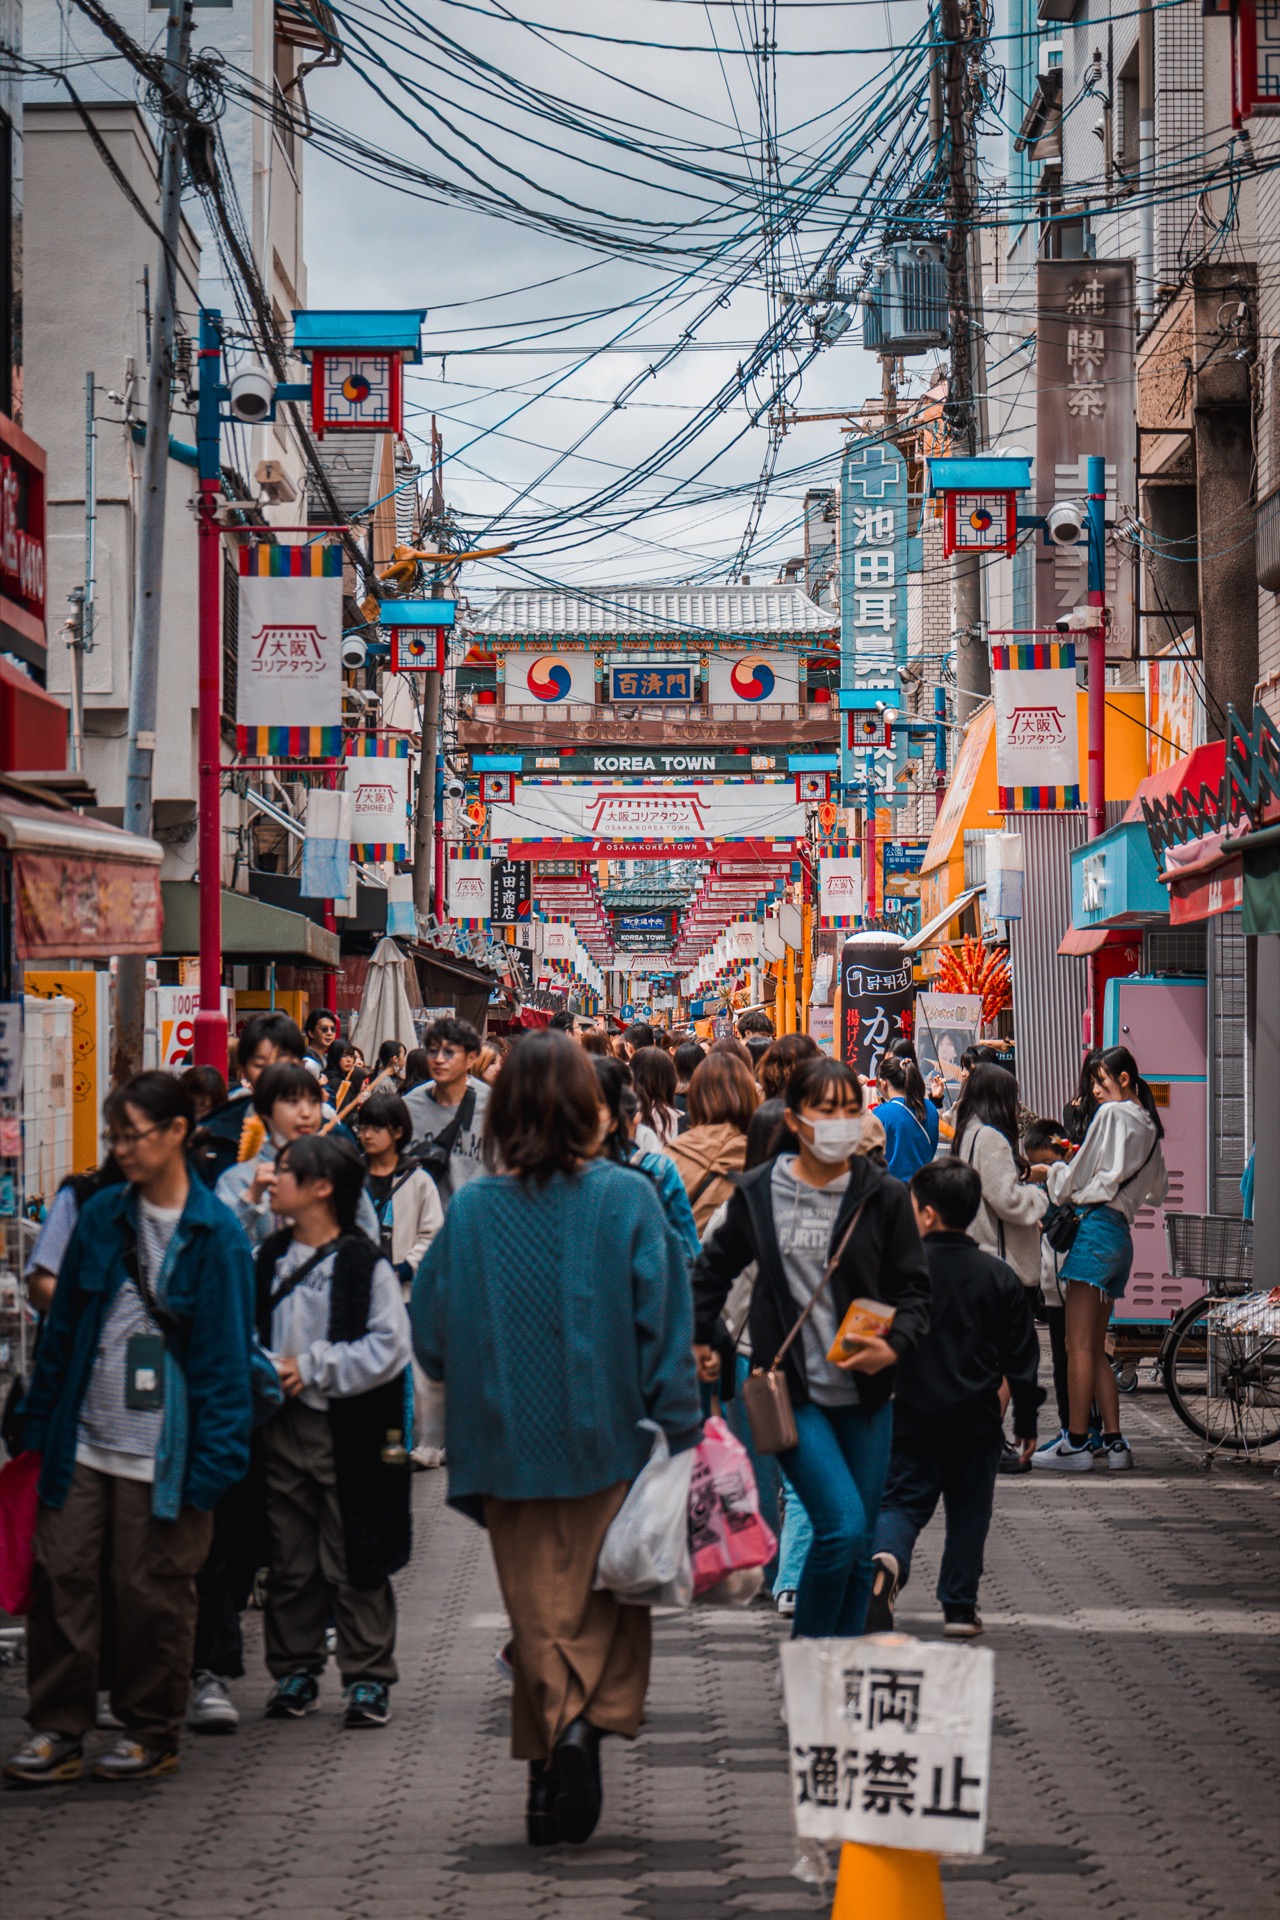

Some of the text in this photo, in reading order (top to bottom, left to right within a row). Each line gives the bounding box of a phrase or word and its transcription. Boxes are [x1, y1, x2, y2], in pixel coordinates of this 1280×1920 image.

[270, 640, 307, 657] 大阪
[853, 506, 897, 802] 池田耳鼻科
[251, 660, 326, 673] コリアタウン
[568, 724, 737, 741] KOREA TOWN
[1021, 719, 1051, 732] 大阪
[1007, 734, 1066, 745] コリアタウン
[593, 757, 716, 771] KOREA TOWN
[363, 793, 386, 803] 大阪
[606, 812, 689, 822] 大阪コリアタウン
[501, 861, 517, 920] 山田商店
[867, 971, 907, 990] 닭튀김
